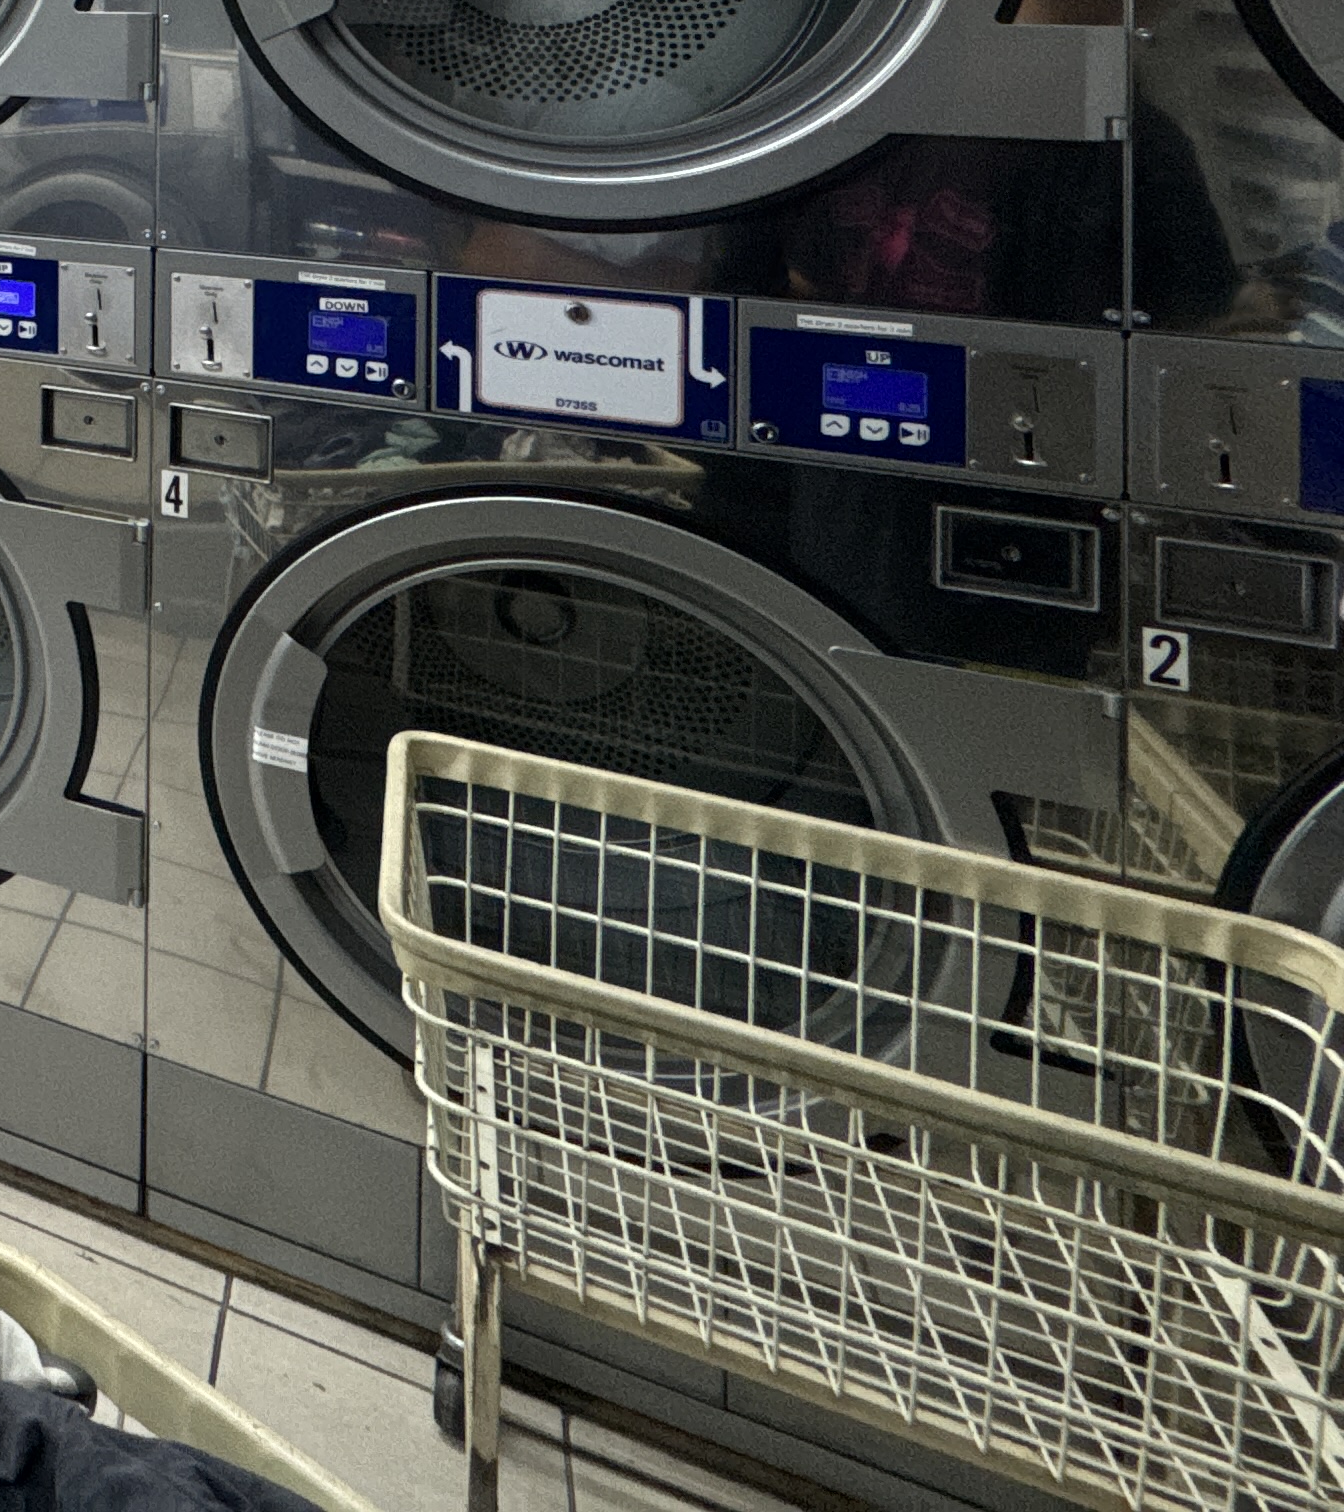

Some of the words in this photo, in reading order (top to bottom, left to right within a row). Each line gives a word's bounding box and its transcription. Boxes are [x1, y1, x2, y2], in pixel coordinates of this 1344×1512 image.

[325, 301, 365, 312] DOWN
[553, 347, 665, 373] wascomat
[867, 352, 891, 363] UP
[165, 474, 184, 513] 4
[1149, 633, 1182, 686] 2
